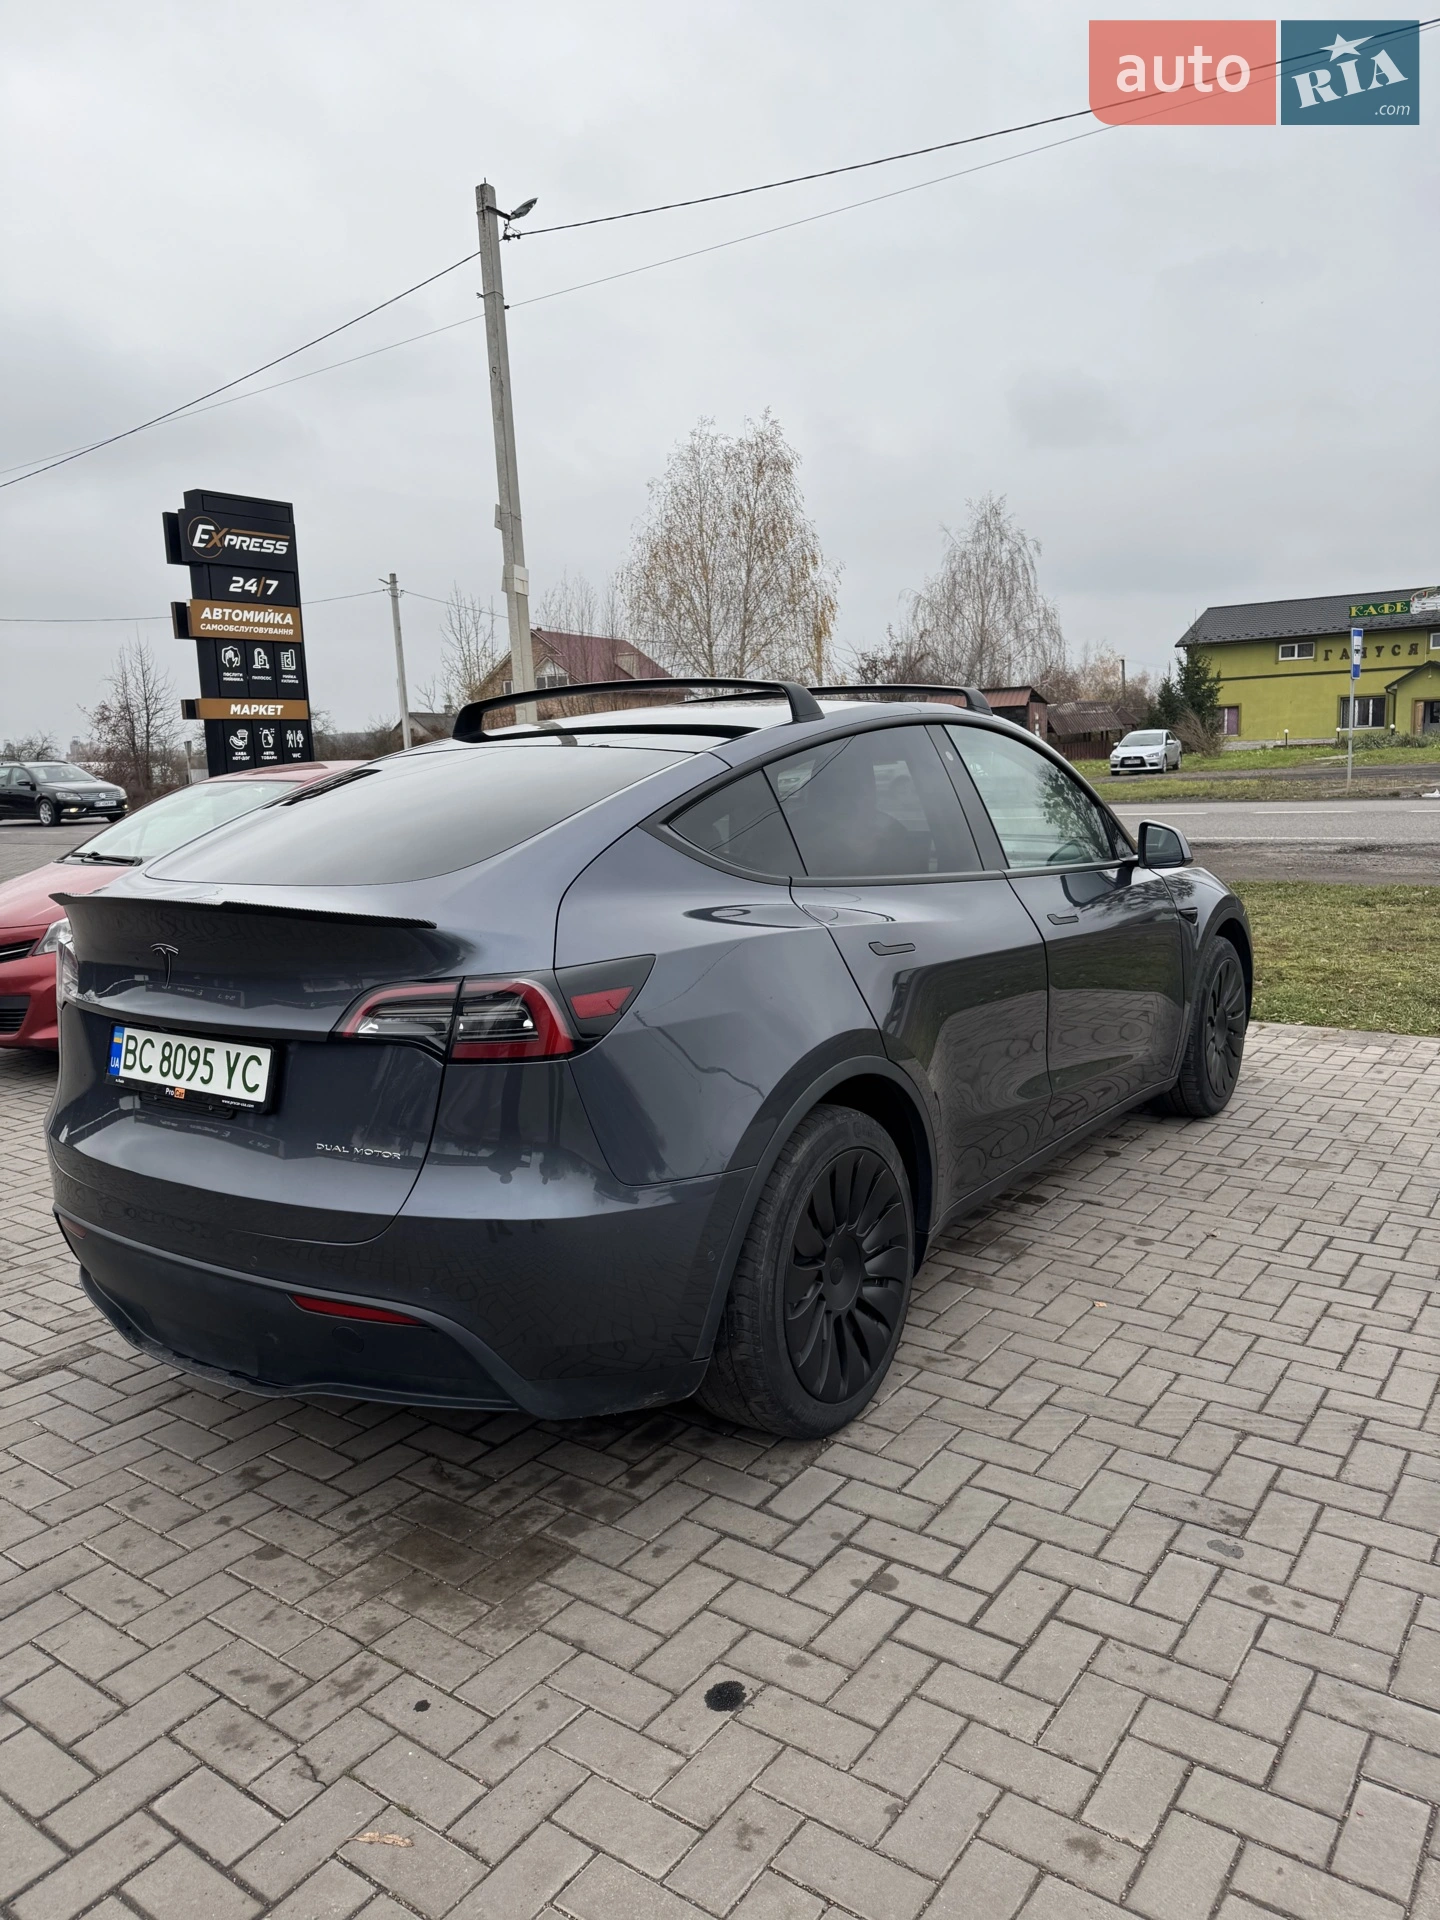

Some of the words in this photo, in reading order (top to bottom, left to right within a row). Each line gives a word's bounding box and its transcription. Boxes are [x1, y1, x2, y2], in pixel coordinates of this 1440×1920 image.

[192, 524, 289, 554] EXPRESS
[228, 576, 279, 597] 24/7
[200, 607, 294, 625] АВТОМИЙКА
[1350, 601, 1409, 617] КАФЕ
[200, 623, 294, 636] САМООБСЛУГОВУВАННЯ
[229, 703, 284, 716] МАРКЕТ
[110, 1056, 120, 1069] UA
[123, 1034, 155, 1074] BC
[159, 1041, 216, 1085] 8095
[225, 1050, 263, 1093] YC
[316, 1142, 350, 1153] DUAL
[353, 1147, 401, 1160] MOTOR
